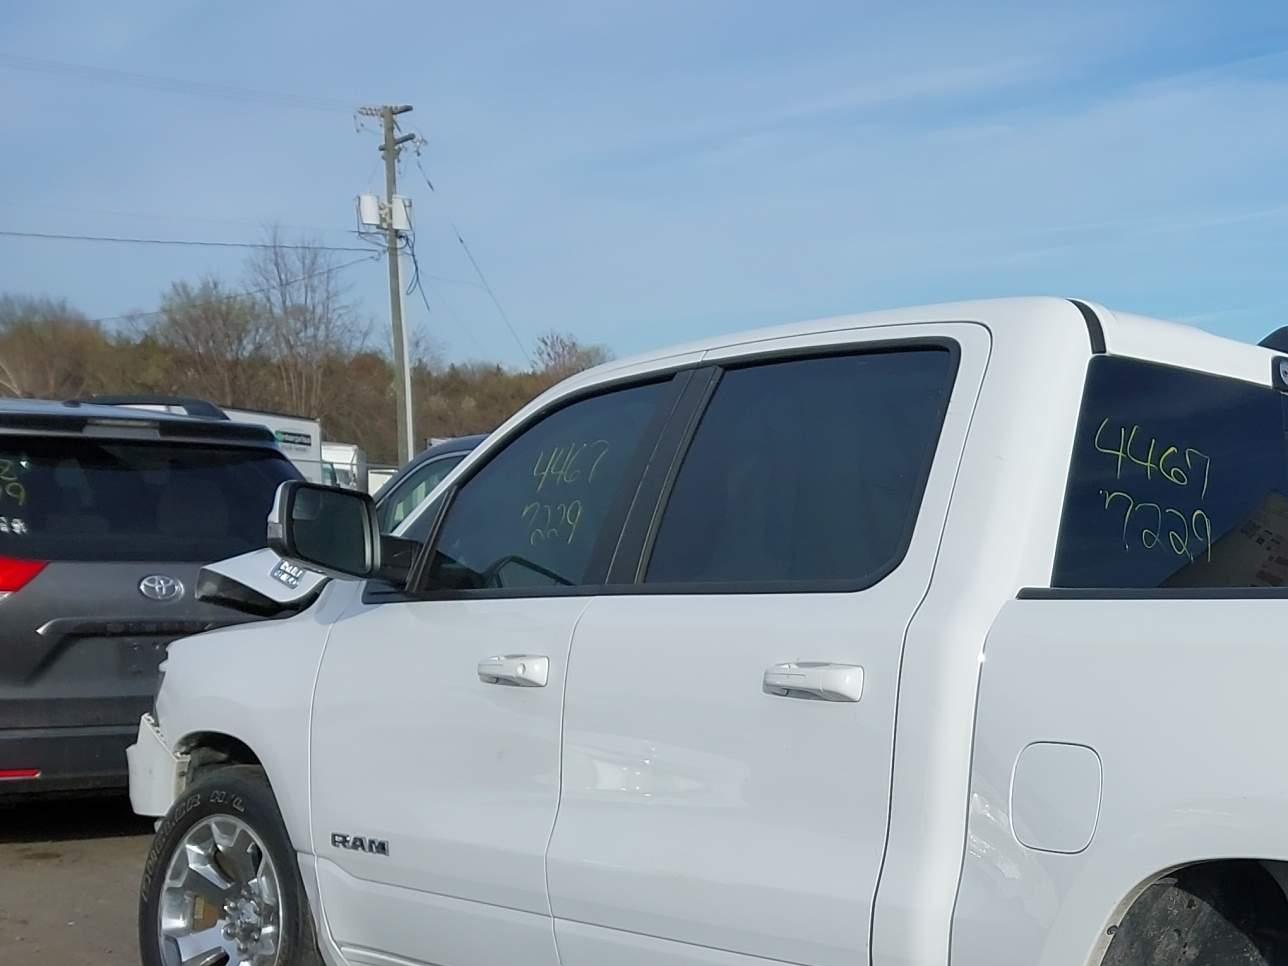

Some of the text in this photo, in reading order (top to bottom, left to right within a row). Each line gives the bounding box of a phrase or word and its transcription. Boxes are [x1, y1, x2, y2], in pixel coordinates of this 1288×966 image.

[532, 438, 609, 492] 4467
[1094, 415, 1210, 499] 4467
[1099, 488, 1212, 563] 7229
[331, 832, 390, 857] RAM
